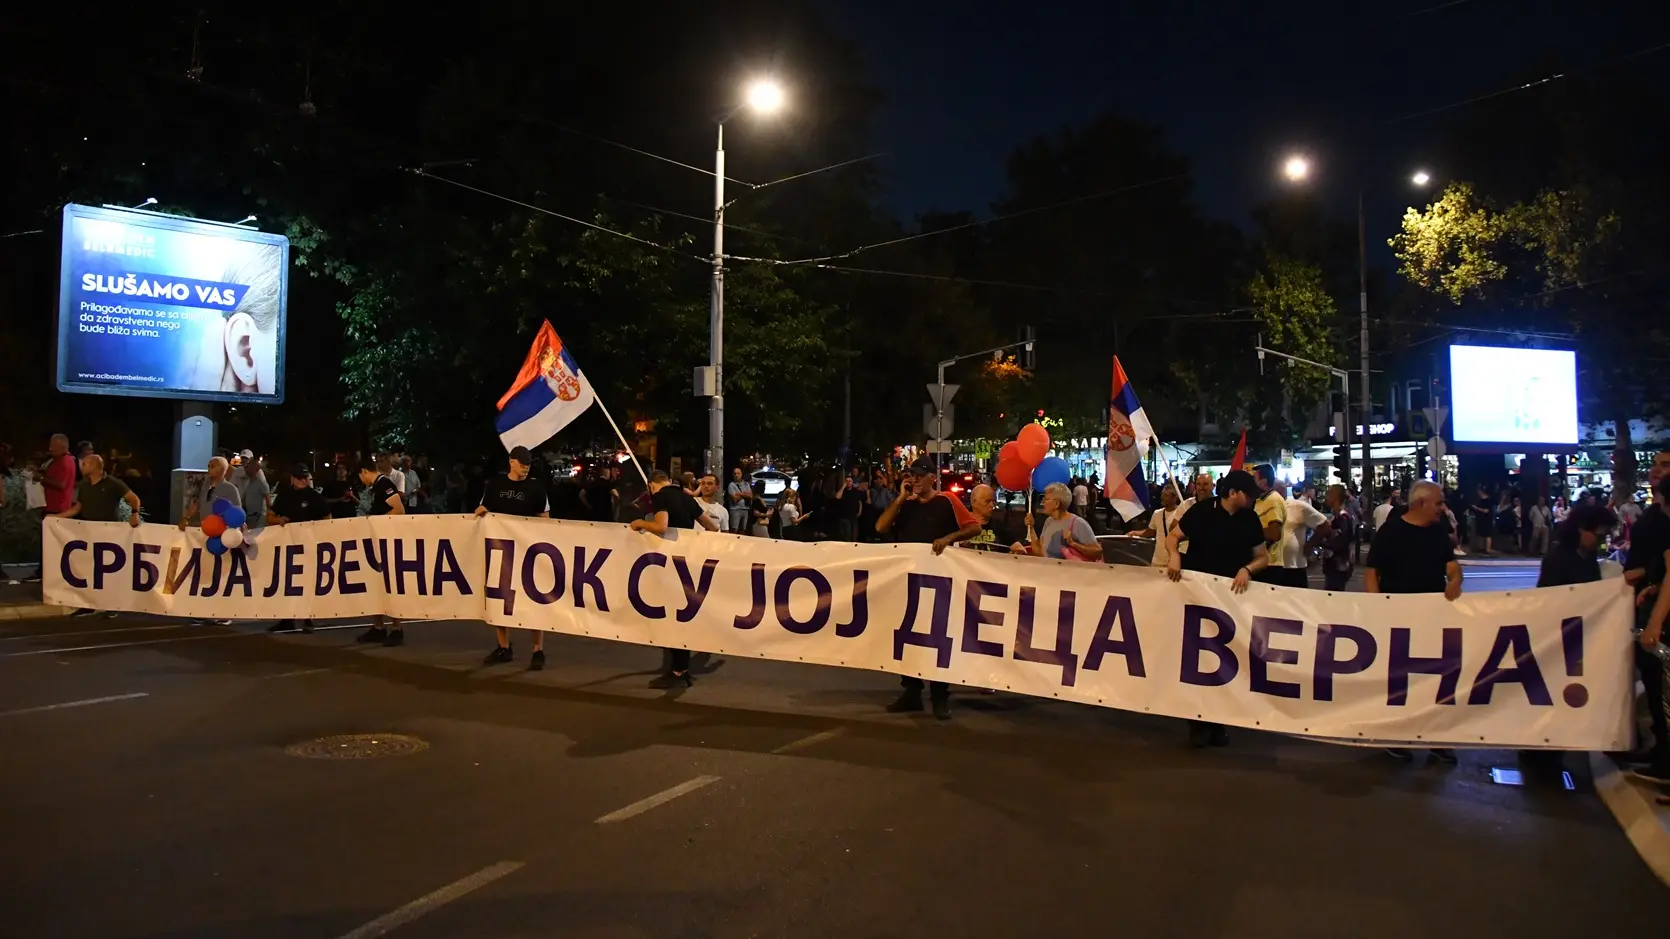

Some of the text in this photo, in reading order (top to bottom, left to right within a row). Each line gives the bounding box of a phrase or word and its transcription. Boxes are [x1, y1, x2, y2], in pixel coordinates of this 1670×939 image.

[81, 273, 236, 306] SLUŠAMO VAS
[80, 301, 154, 317] Prilagođavamo
[155, 310, 166, 318] se
[167, 311, 179, 320] sa
[79, 312, 181, 331] da zdravstvena nega
[79, 322, 161, 338] bude bliža svima.
[78, 372, 164, 383] www.acibadembelmedic.rs
[60, 537, 1590, 709] СРБИЈА ЈЕ ВЕЧНА ДОК СУ ЈОЈ ДЕЦА ВЕРНА!
